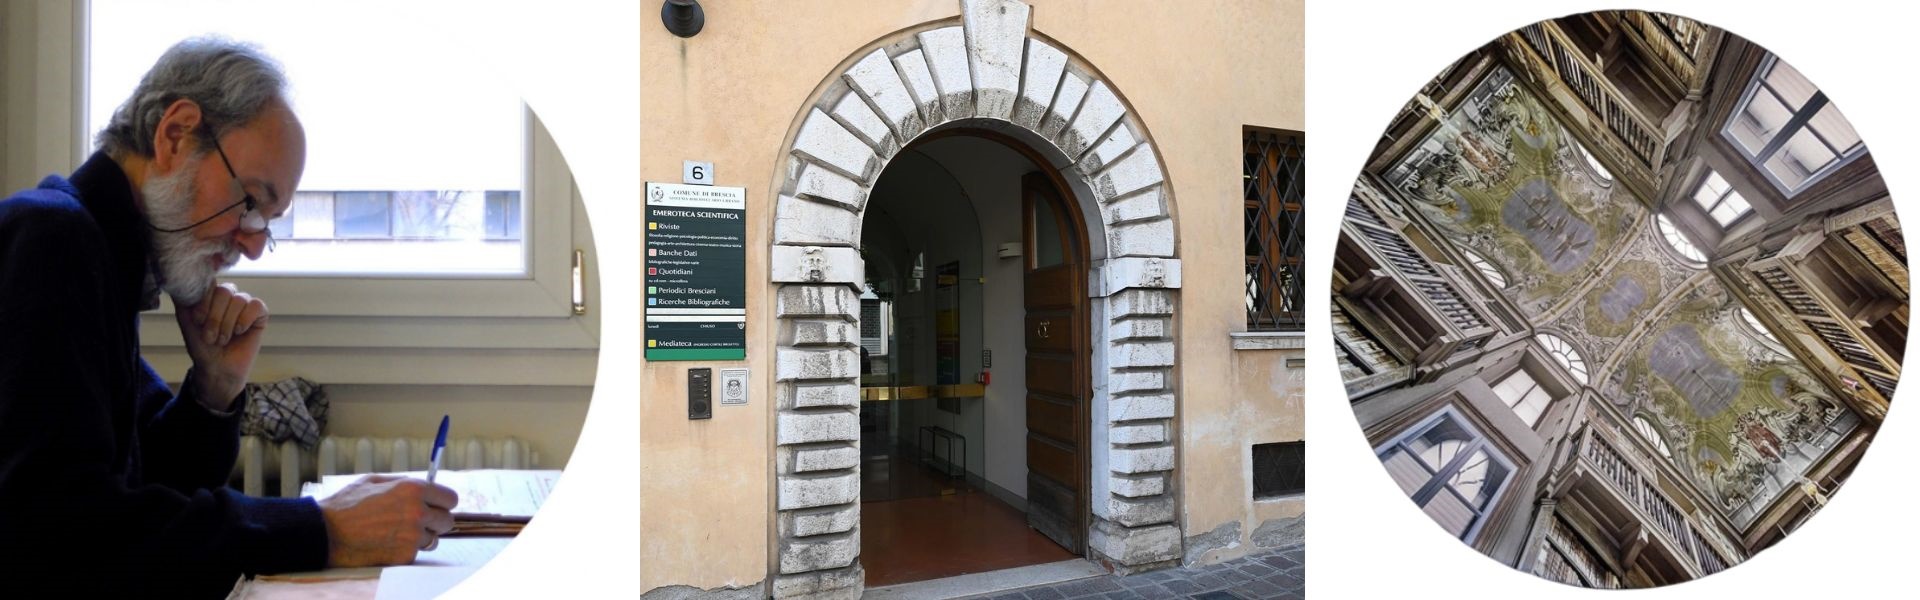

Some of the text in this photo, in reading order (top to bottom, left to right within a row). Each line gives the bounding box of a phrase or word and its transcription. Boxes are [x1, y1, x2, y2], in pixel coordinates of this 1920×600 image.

[692, 166, 704, 180] 6
[652, 210, 739, 220] EMEROTECA SCIENTIFICA
